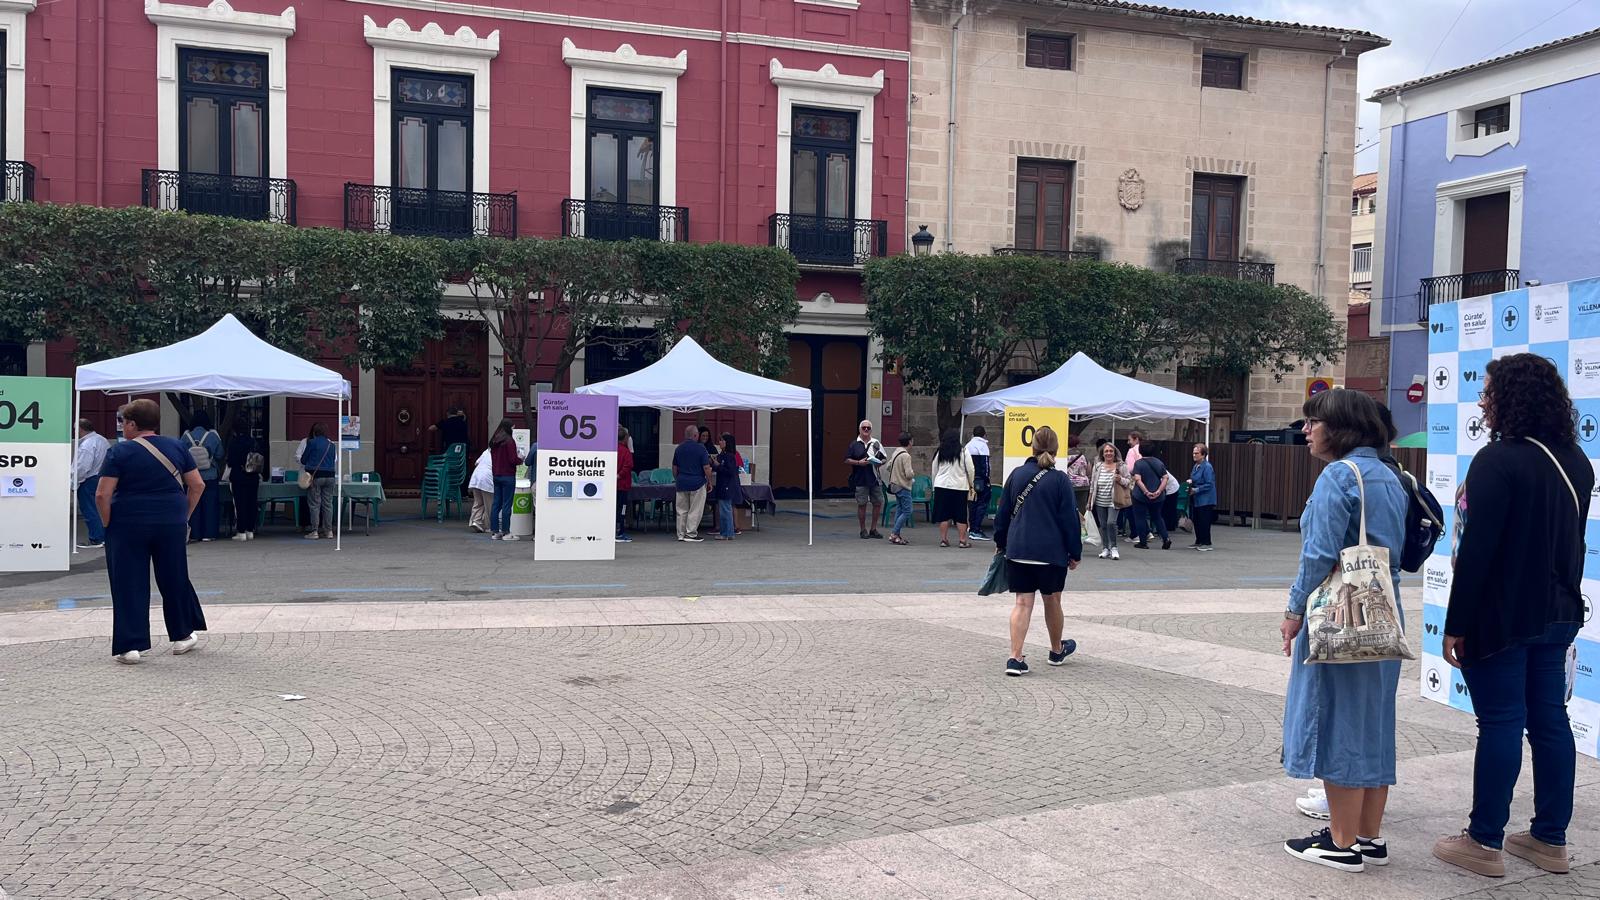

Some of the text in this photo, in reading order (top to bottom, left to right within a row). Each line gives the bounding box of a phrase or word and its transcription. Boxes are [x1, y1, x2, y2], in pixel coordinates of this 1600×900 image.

[1471, 319, 1486, 327] salud
[0, 401, 44, 430] 04
[560, 415, 597, 440] 05
[0, 455, 37, 467] SPD
[549, 457, 605, 469] Botiquín
